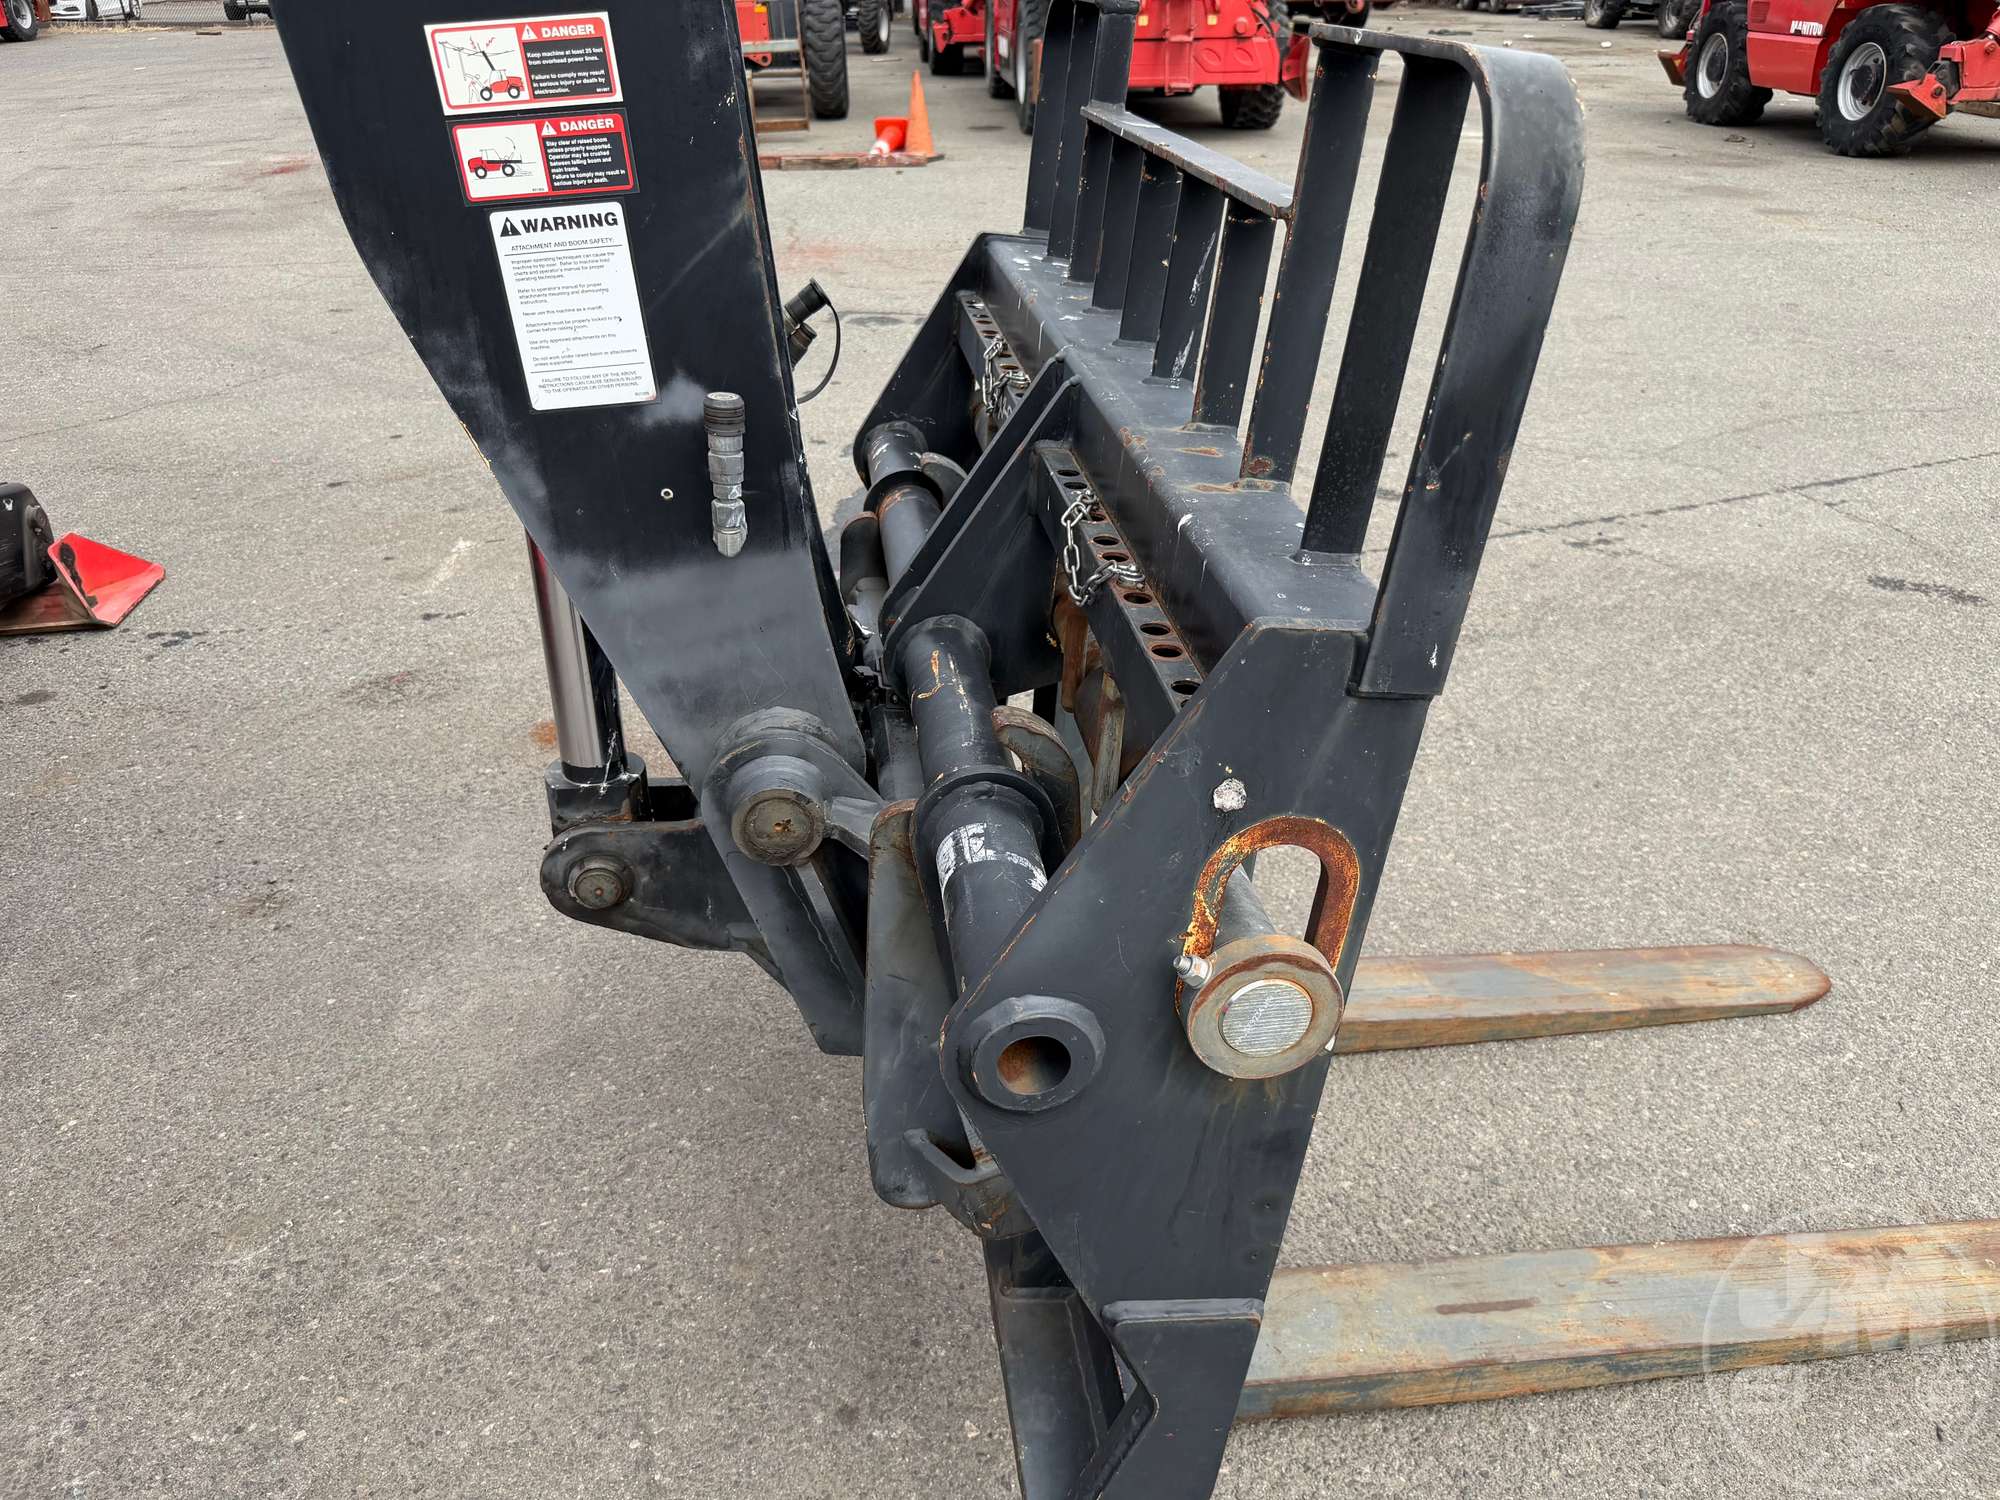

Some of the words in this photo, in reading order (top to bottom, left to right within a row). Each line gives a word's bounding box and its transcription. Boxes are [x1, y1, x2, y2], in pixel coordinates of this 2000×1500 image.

[541, 24, 595, 38] DANGER
[1790, 20, 1823, 36] MANITOU
[560, 119, 614, 132] DANGER
[521, 212, 618, 233] WARNING
[511, 243, 552, 251] ATTACHMENT
